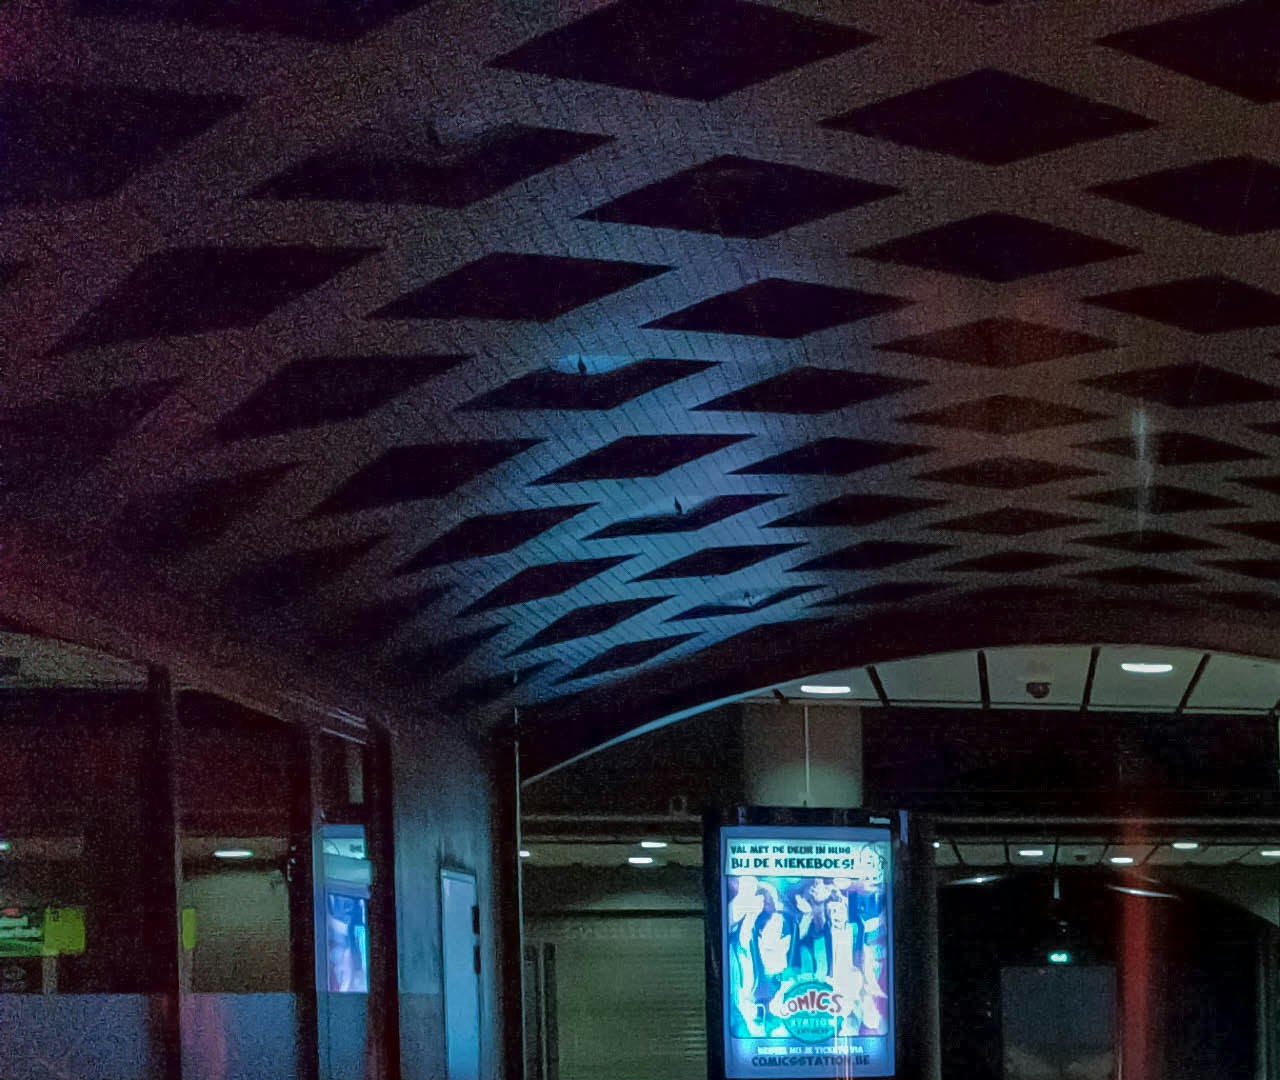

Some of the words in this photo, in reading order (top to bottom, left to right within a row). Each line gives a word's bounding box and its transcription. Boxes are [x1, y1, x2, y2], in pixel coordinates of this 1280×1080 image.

[730, 845, 747, 854] VAL
[749, 845, 769, 854] MET
[815, 846, 826, 854] IN
[731, 857, 750, 869] BIJ
[753, 857, 769, 868] DE
[774, 857, 855, 870] KIEKEBOES!
